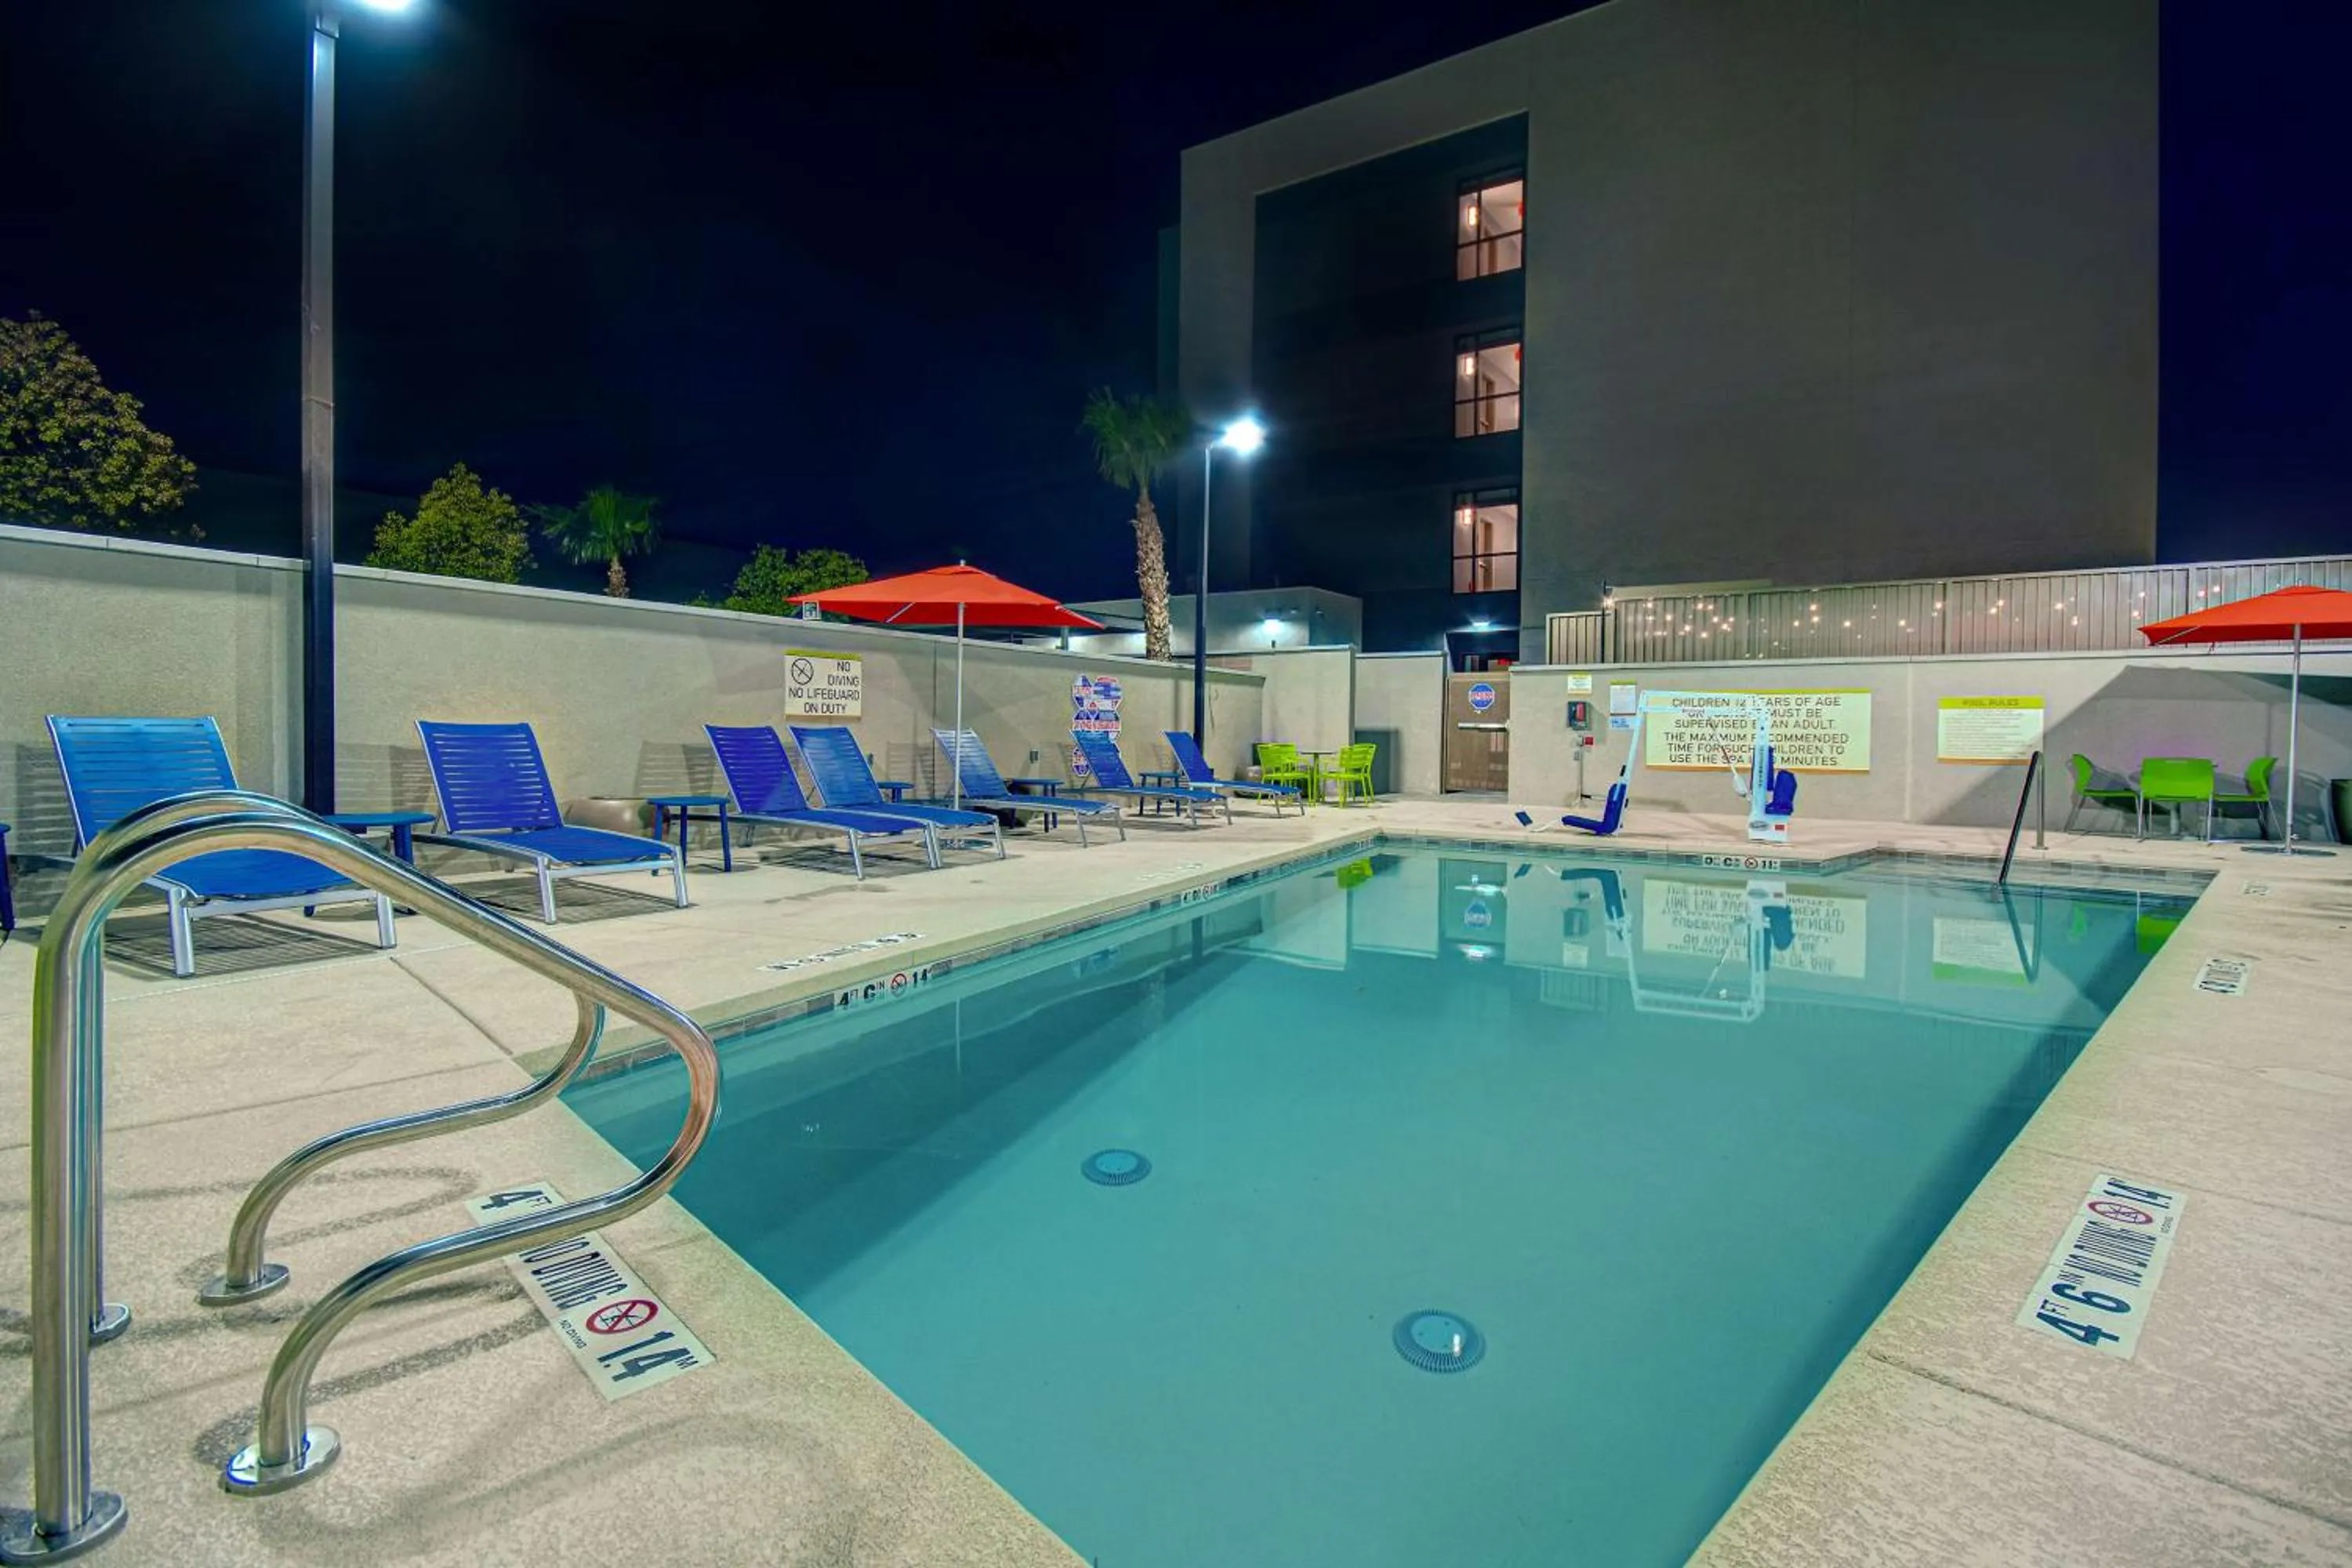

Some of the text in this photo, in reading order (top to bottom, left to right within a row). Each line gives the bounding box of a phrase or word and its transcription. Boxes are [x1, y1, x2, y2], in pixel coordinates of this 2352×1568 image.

[837, 661, 851, 672] NO
[827, 674, 860, 687] DIVING
[789, 688, 860, 701] NO LIFEGUARD
[1672, 697, 1730, 707] CHILDREN
[1795, 697, 1811, 706] OF
[1815, 696, 1841, 706] AGE
[804, 702, 847, 714] ON DUTY
[1806, 708, 1822, 718] BE
[1675, 719, 1748, 728] SUPERVISED
[1771, 719, 1788, 728] AN
[1663, 731, 1686, 742] THE
[1690, 732, 1747, 742] MAXMUM
[1668, 742, 1693, 753] TIME
[1697, 742, 1721, 753] FOR
[1769, 745, 1823, 755] HILDREN
[1828, 745, 1845, 755] TO
[1669, 753, 1692, 763] USE
[1697, 753, 1718, 764] THE
[1780, 755, 1838, 766] MINUTES
